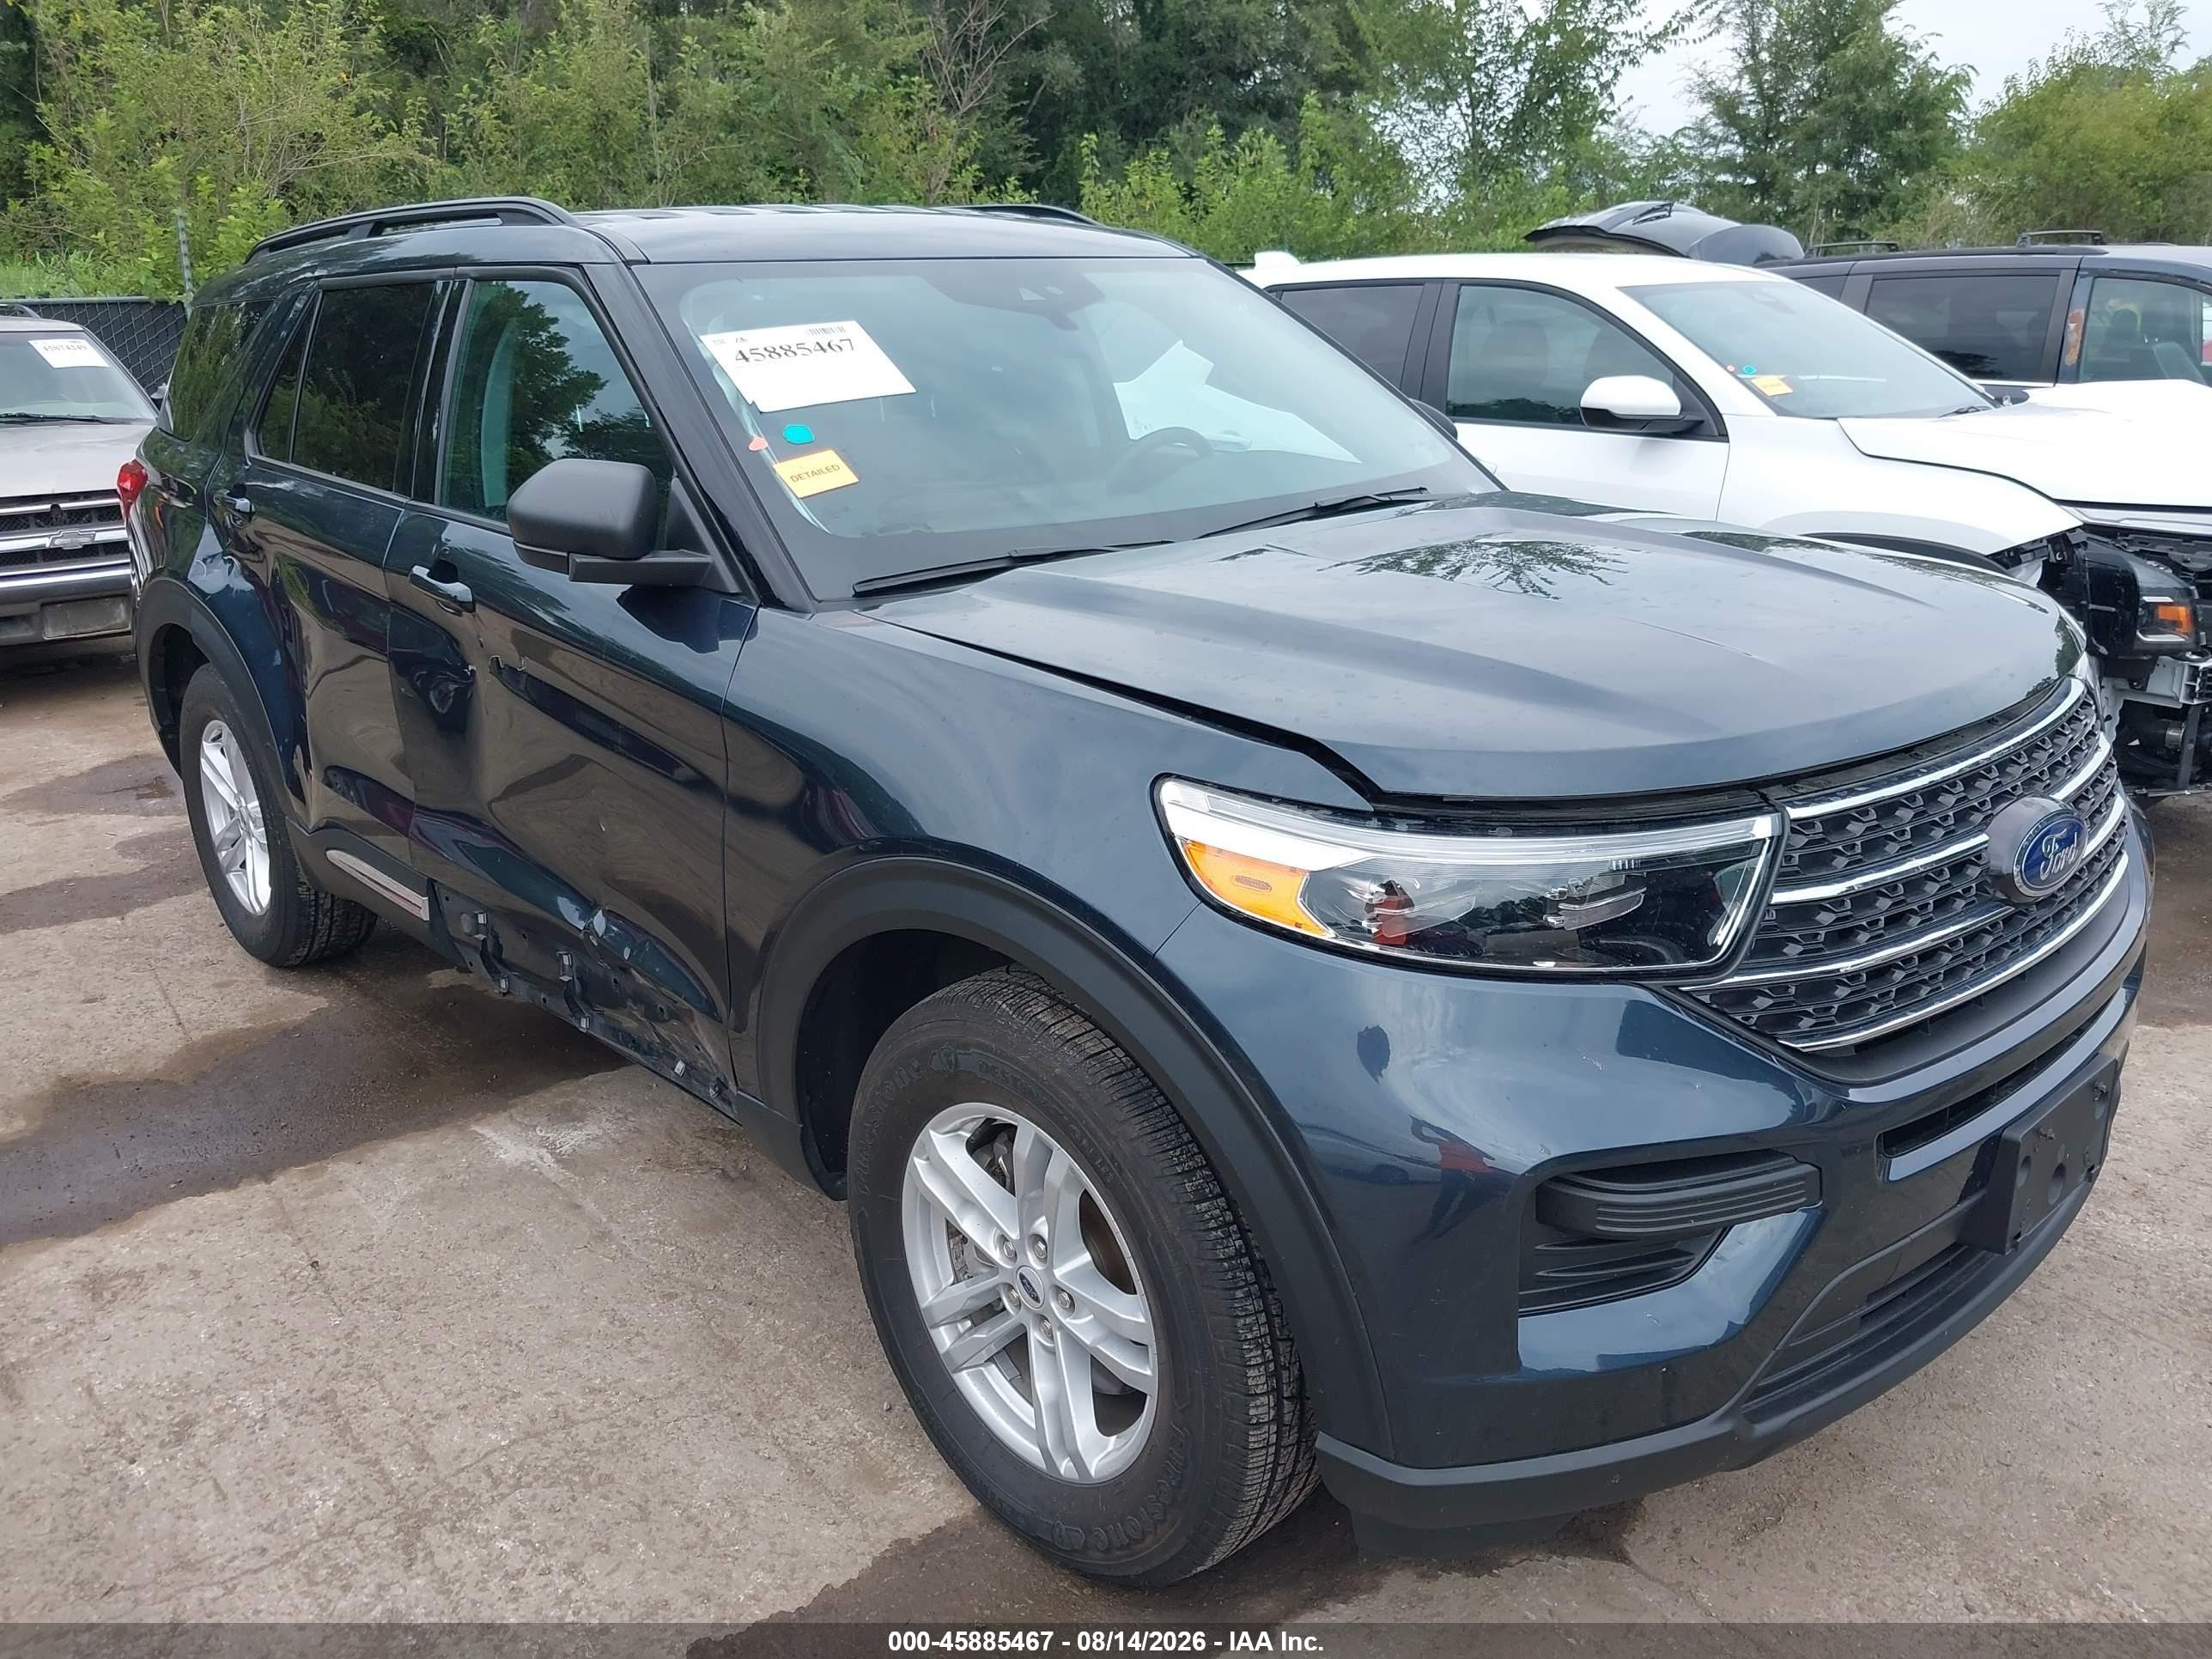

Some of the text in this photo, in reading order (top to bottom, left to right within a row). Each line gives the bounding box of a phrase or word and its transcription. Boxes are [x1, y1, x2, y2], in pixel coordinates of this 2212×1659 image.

[734, 338, 855, 363] 45885467
[789, 464, 841, 483] DETAILED
[2039, 828, 2078, 881] Ford
[1091, 1421, 1192, 1551] Firestone
